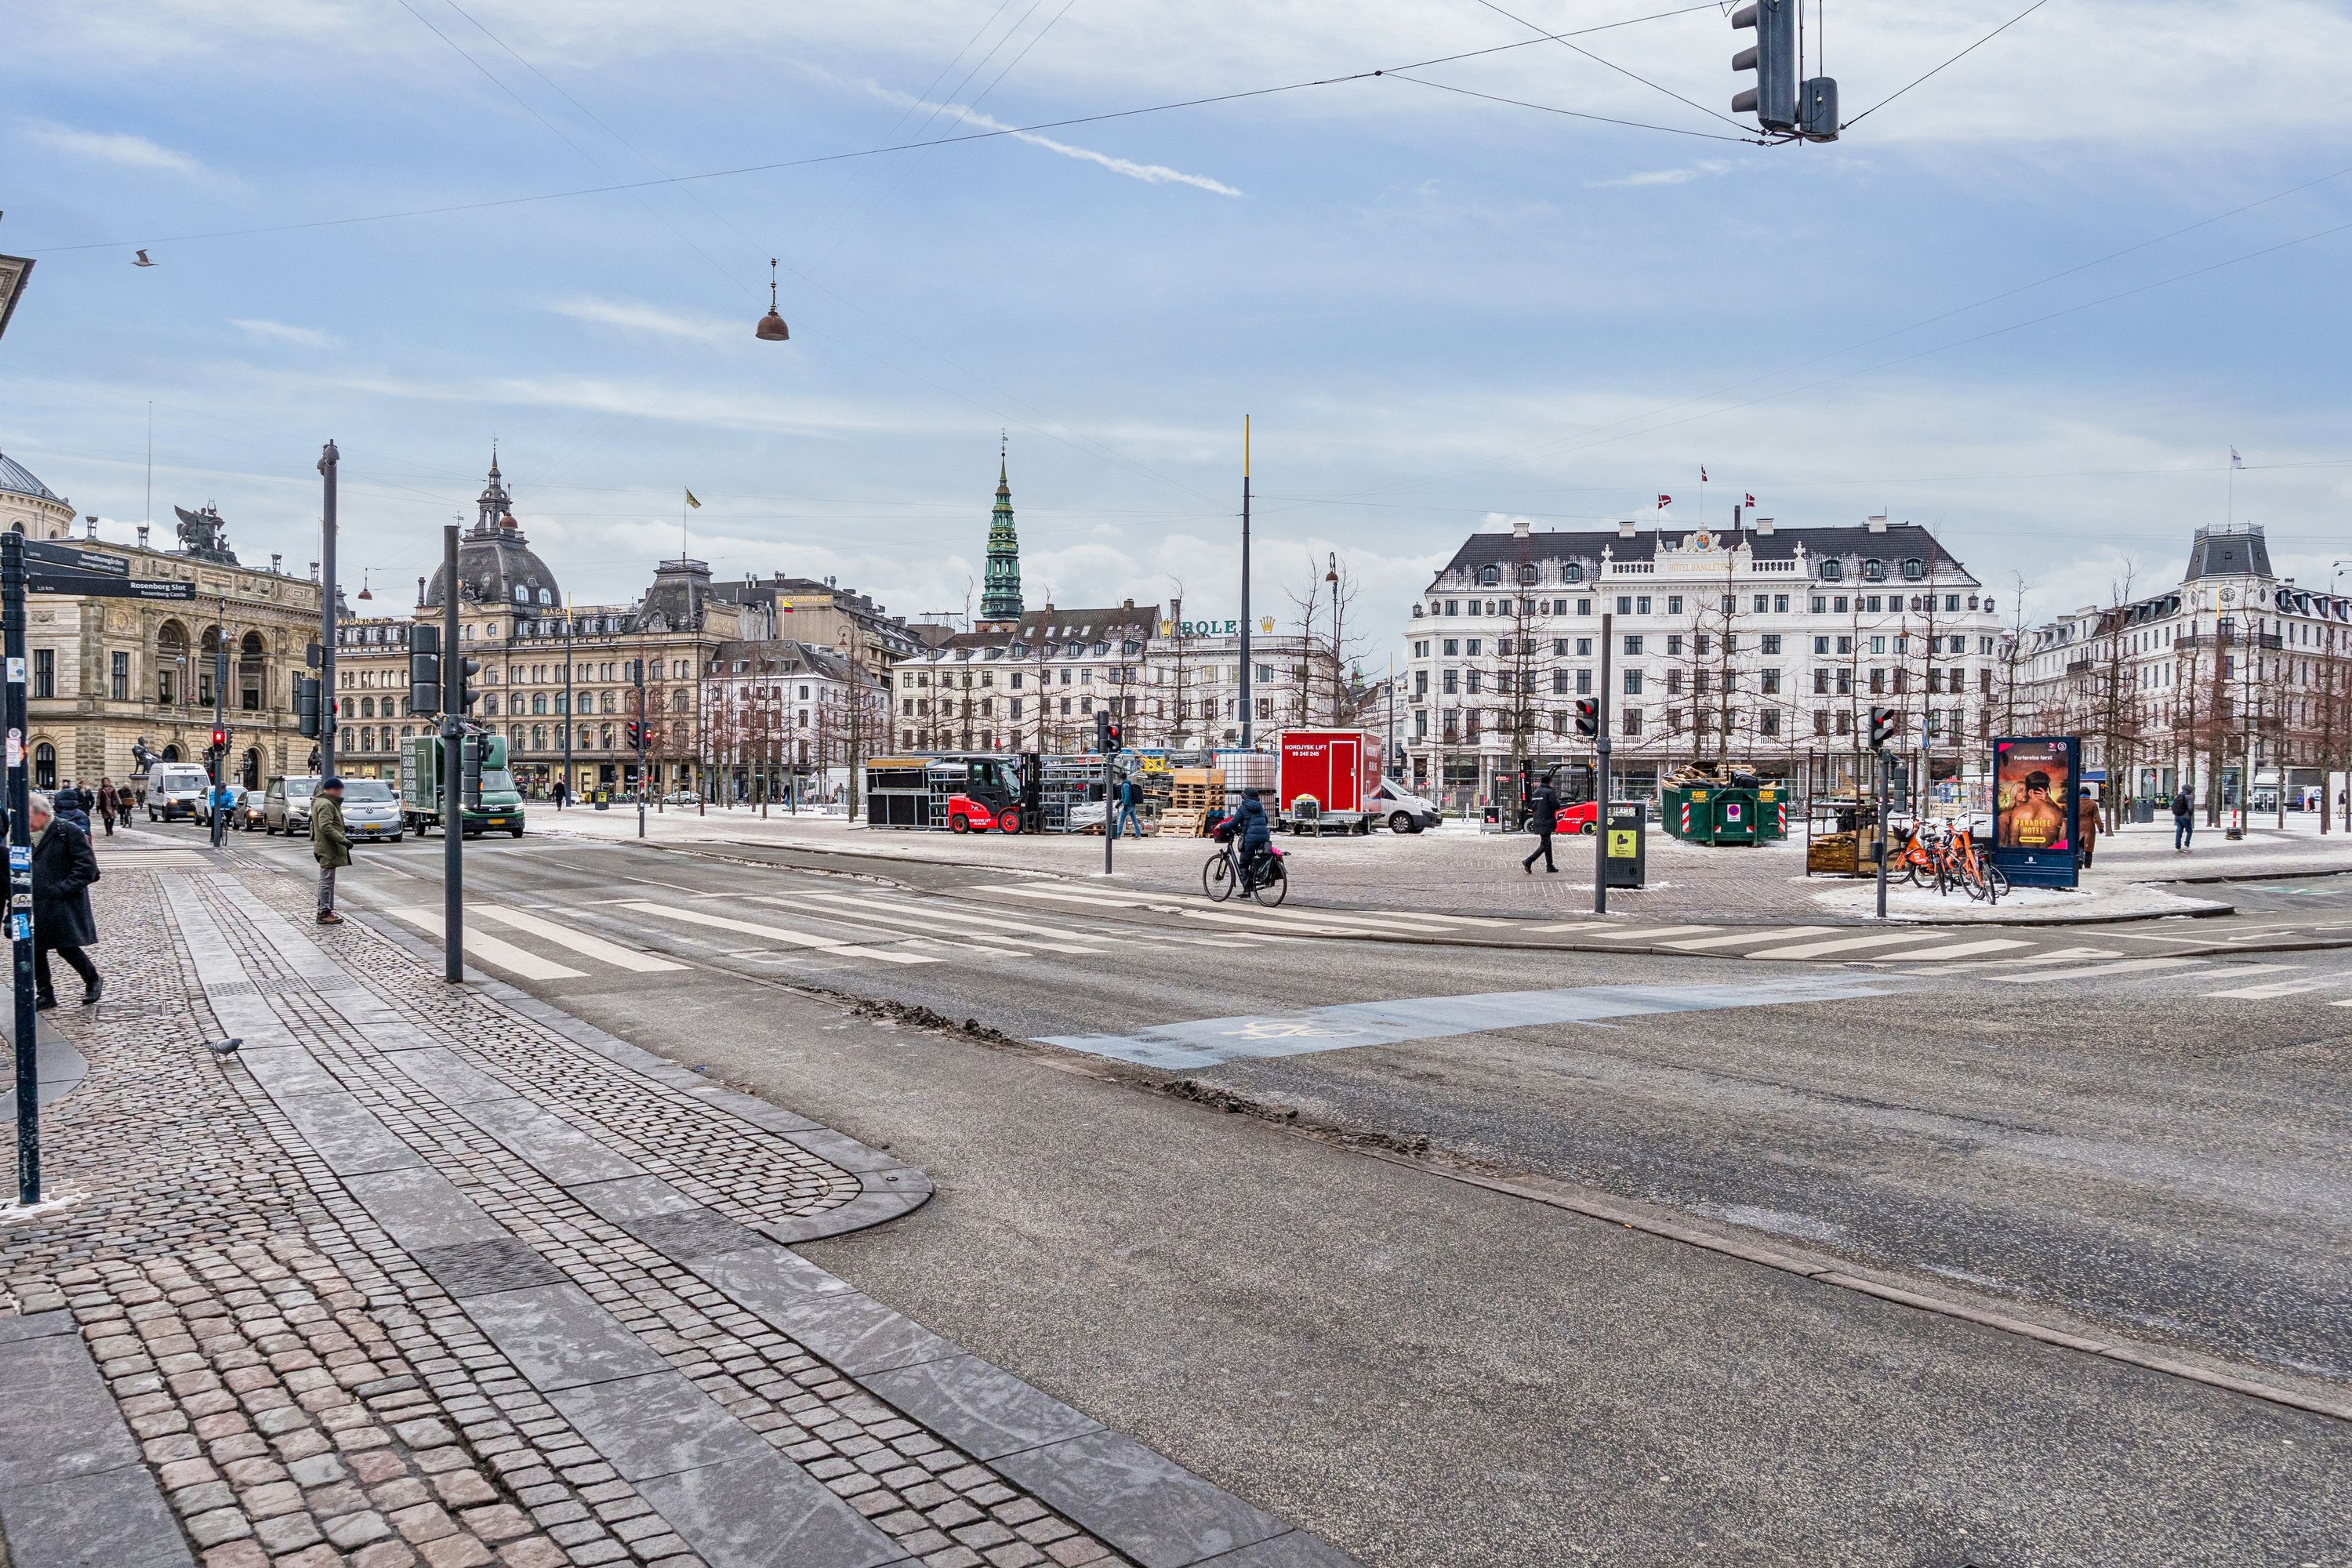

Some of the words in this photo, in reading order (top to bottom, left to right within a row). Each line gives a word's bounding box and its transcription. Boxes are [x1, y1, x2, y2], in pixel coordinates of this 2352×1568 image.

[130, 582, 170, 591] Rosenborg
[338, 618, 373, 626] MAGASIN
[1181, 619, 1253, 635] ROLE
[2015, 818, 2051, 827] PARADISE
